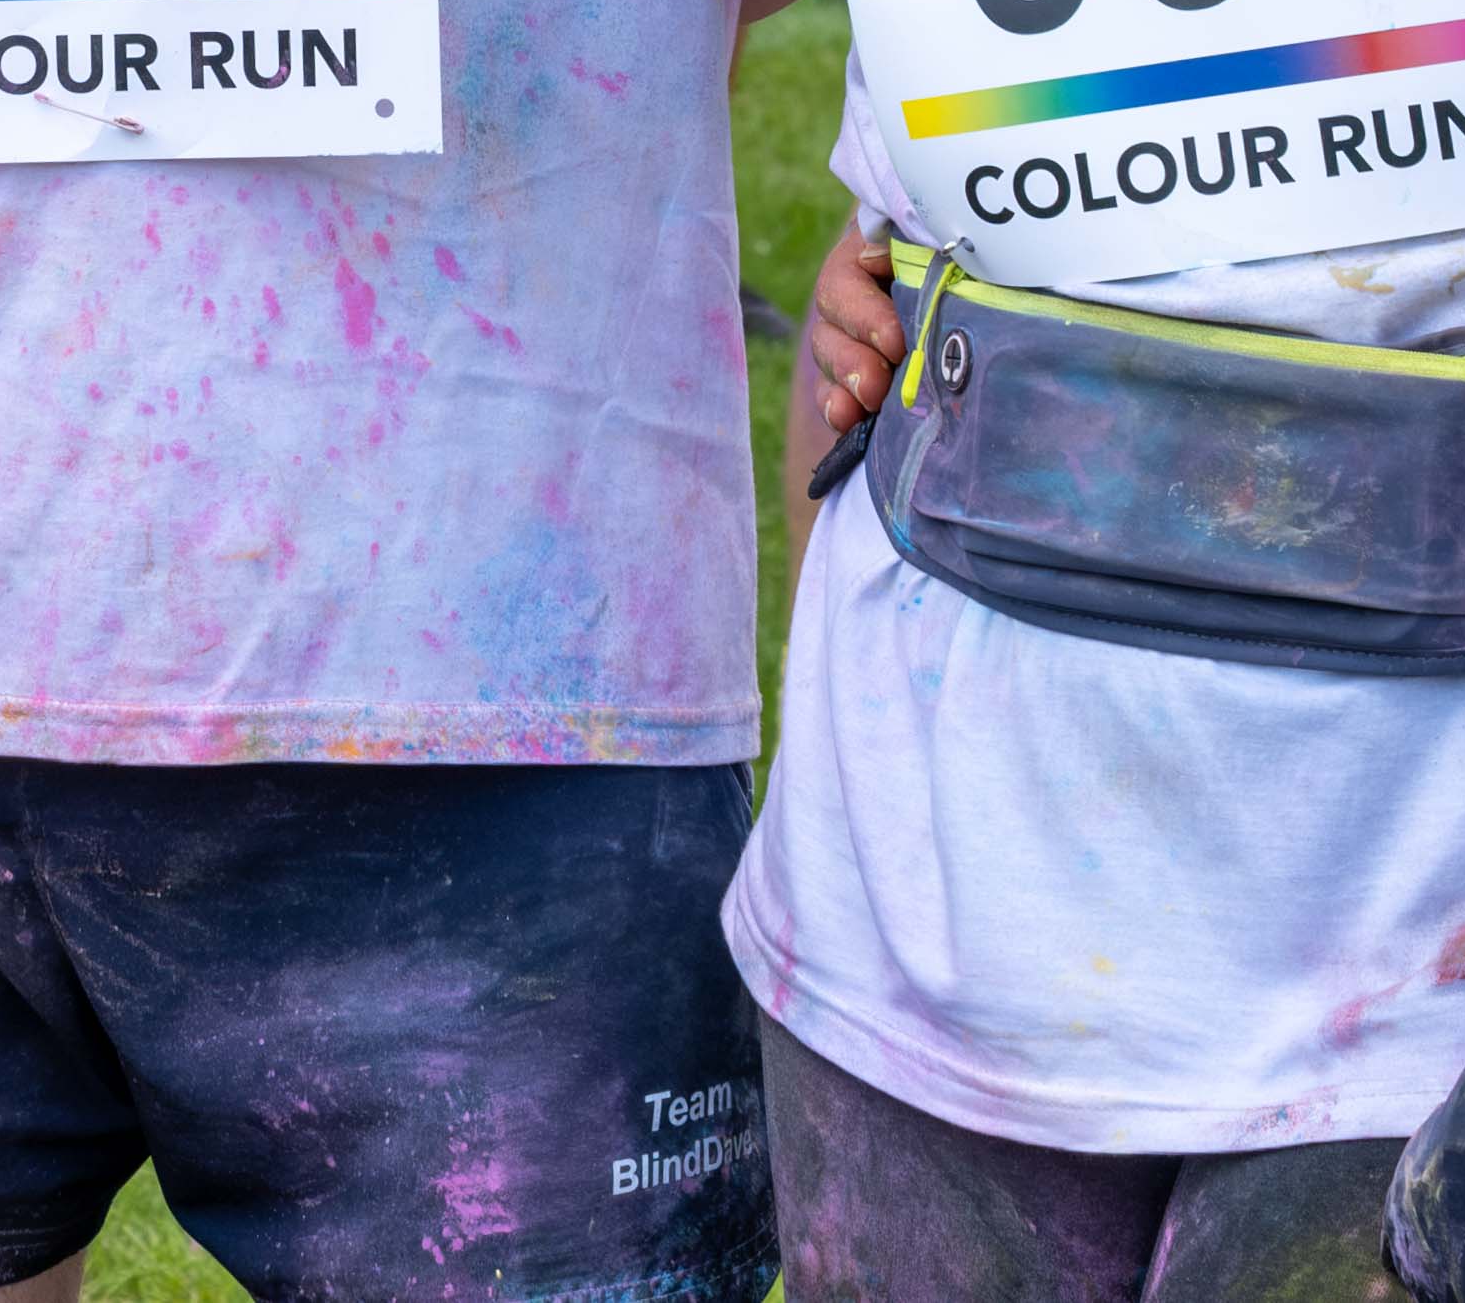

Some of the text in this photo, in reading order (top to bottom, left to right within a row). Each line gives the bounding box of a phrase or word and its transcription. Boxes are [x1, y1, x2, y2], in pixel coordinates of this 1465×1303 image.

[190, 29, 357, 89] RUN
[965, 127, 1295, 224] COLOUR
[644, 1081, 732, 1132] Team
[612, 1127, 753, 1195] BlindDave
